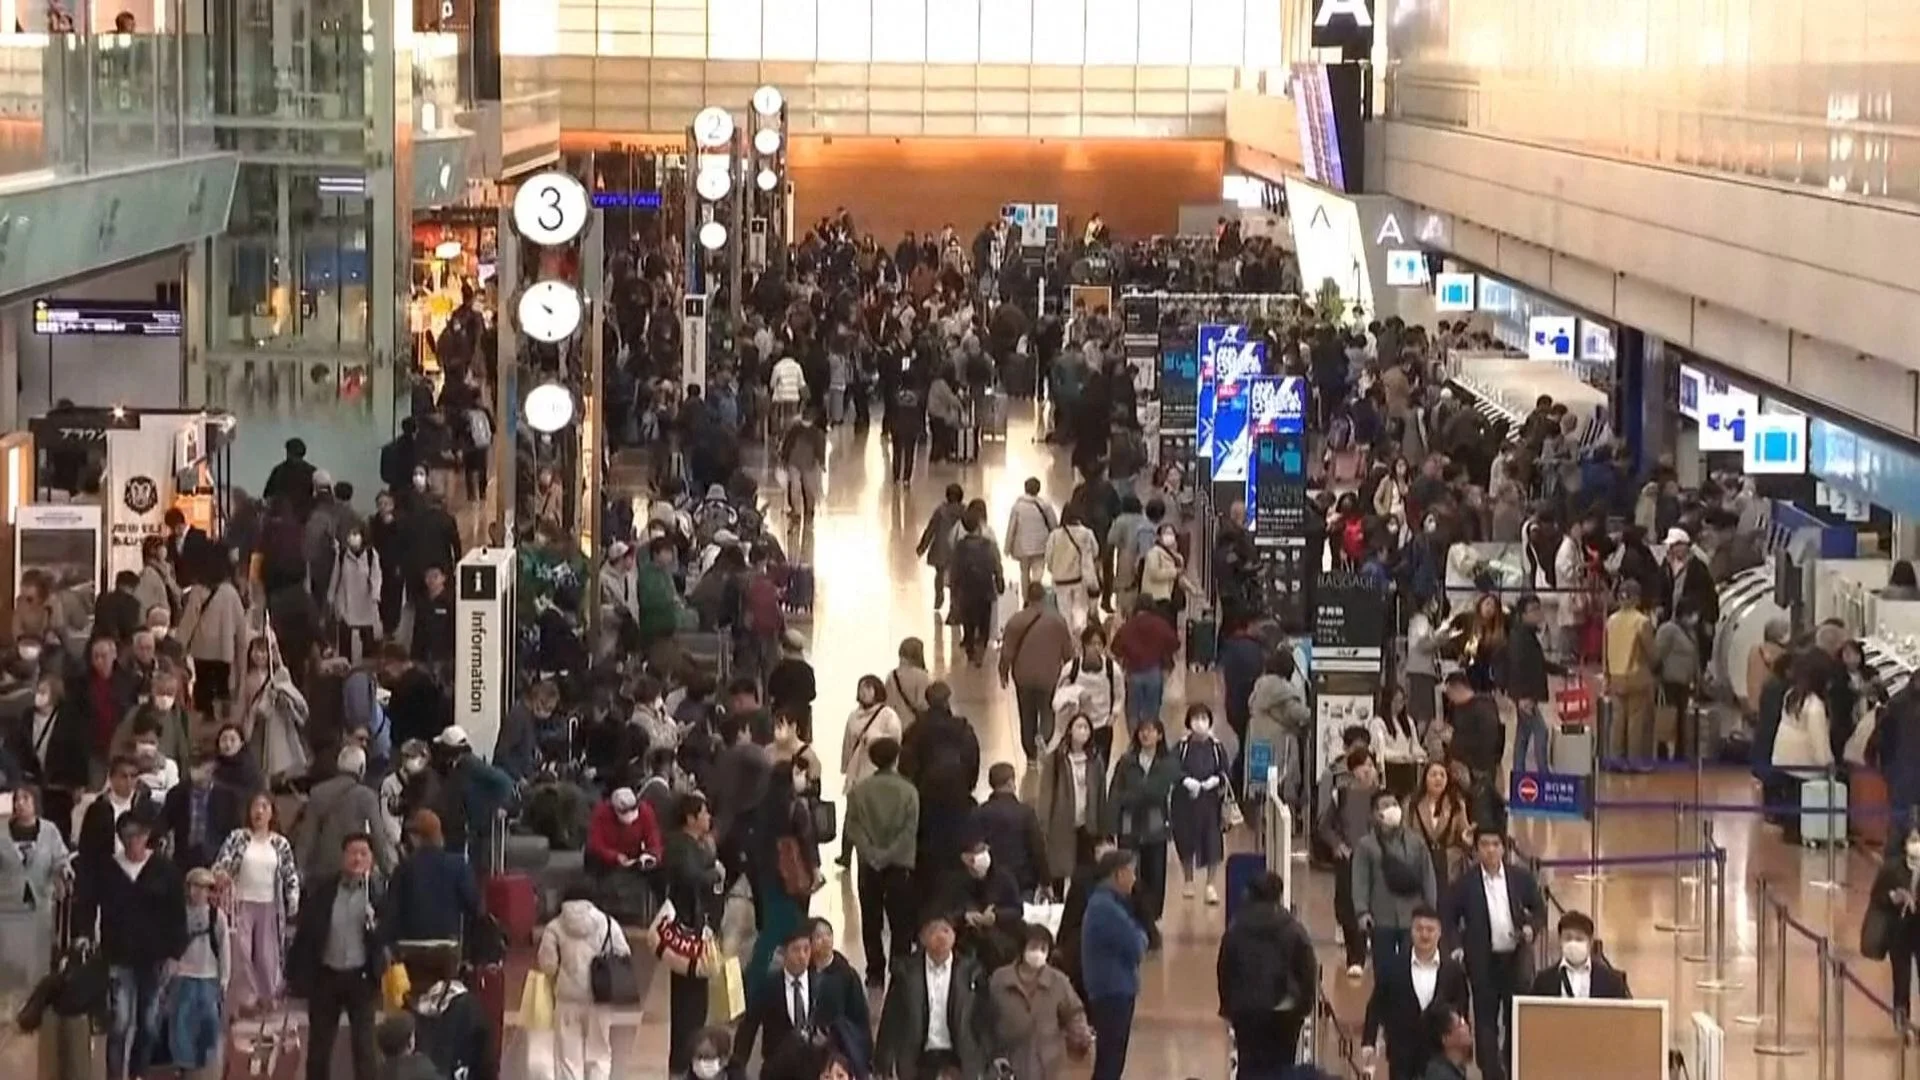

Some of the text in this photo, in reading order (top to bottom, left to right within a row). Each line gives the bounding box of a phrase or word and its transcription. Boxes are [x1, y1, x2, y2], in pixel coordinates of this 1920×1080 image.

[707, 114, 721, 140] 2
[537, 186, 564, 232] 3
[1376, 213, 1404, 244] A
[1837, 493, 1847, 509] 2
[1853, 501, 1862, 516] 3
[470, 611, 486, 713] Information
